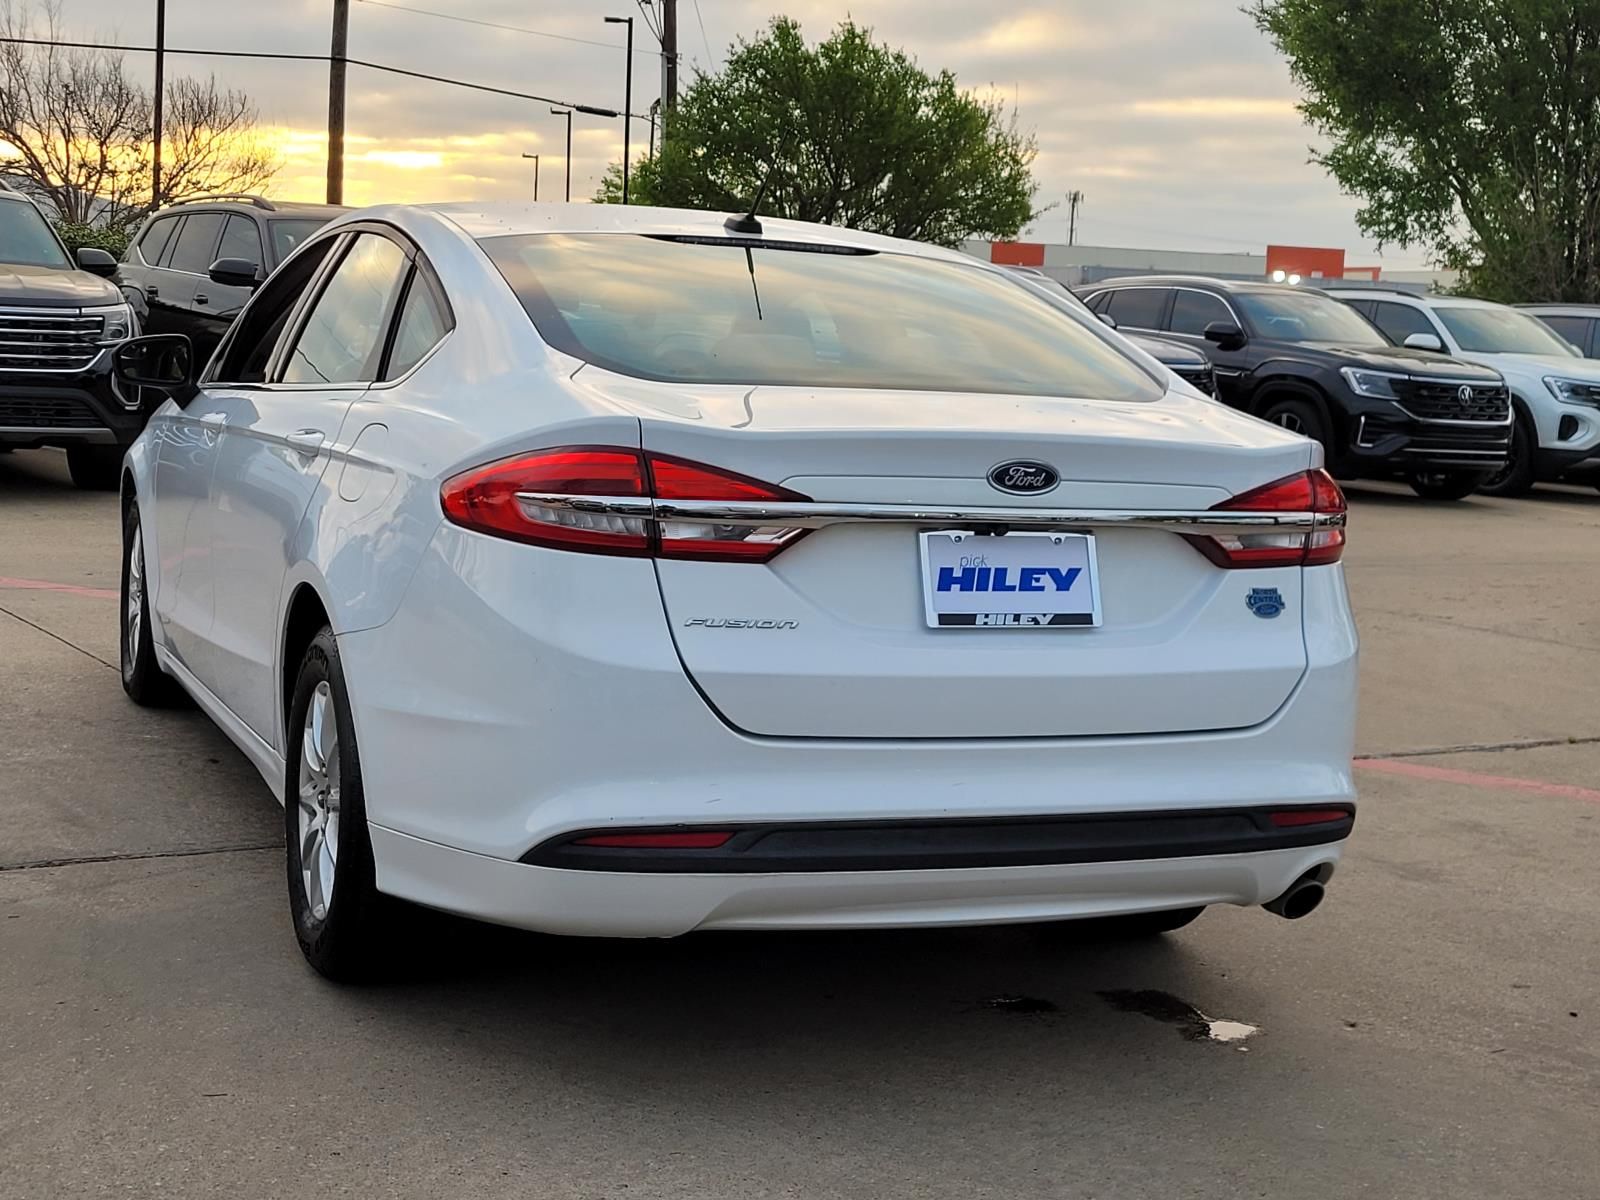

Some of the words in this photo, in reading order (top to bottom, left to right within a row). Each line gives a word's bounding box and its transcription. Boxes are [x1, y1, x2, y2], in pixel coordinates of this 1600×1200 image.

[1004, 466, 1045, 487] Ford
[959, 552, 989, 568] pick
[937, 567, 1082, 592] HILEY
[684, 618, 800, 630] FUSION
[975, 613, 1055, 625] HILEY
